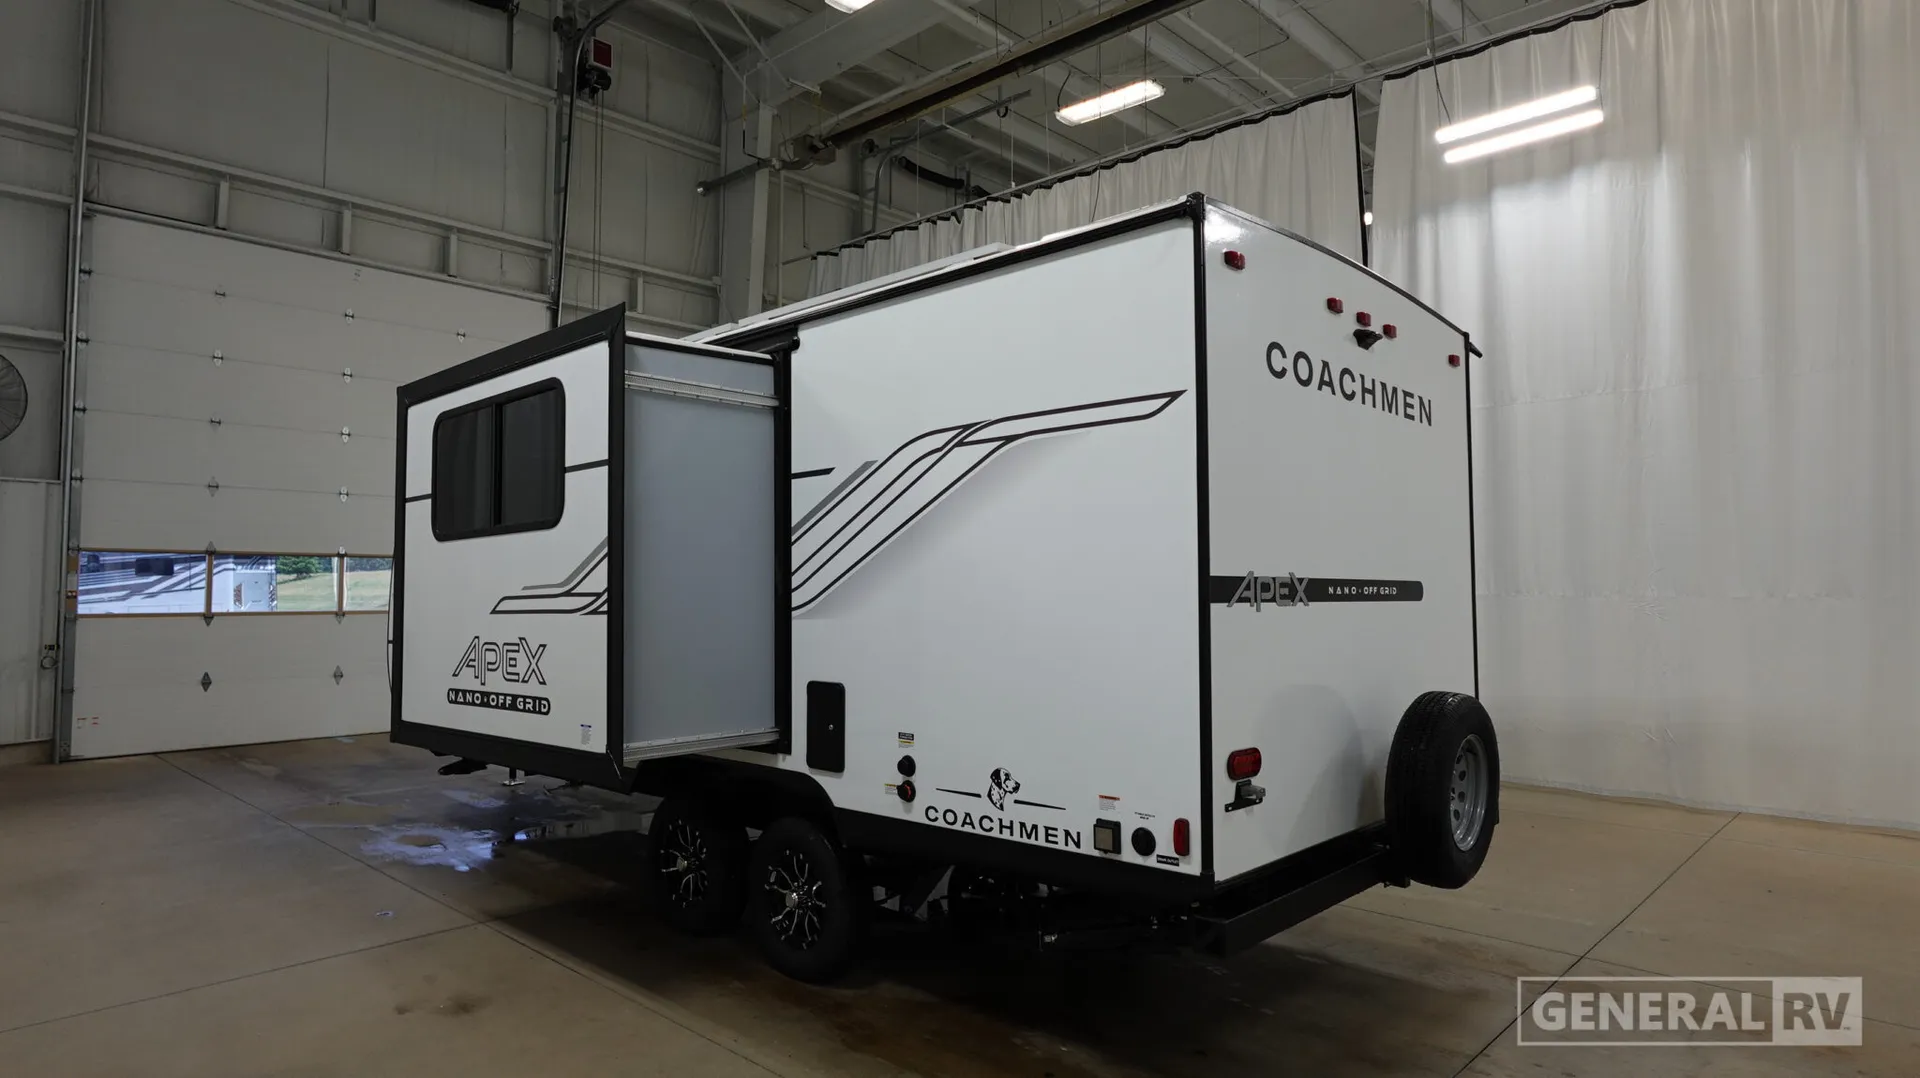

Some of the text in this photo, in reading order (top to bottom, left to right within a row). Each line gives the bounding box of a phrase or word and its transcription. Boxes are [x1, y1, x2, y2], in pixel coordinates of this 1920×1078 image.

[1265, 341, 1432, 427] COACHMEN
[1226, 570, 1310, 612] APEX
[1328, 586, 1397, 595] NANO OFF GRID
[452, 635, 548, 686] APEX
[449, 690, 549, 712] NANO OFF GRID
[924, 805, 1082, 849] COACHMEN
